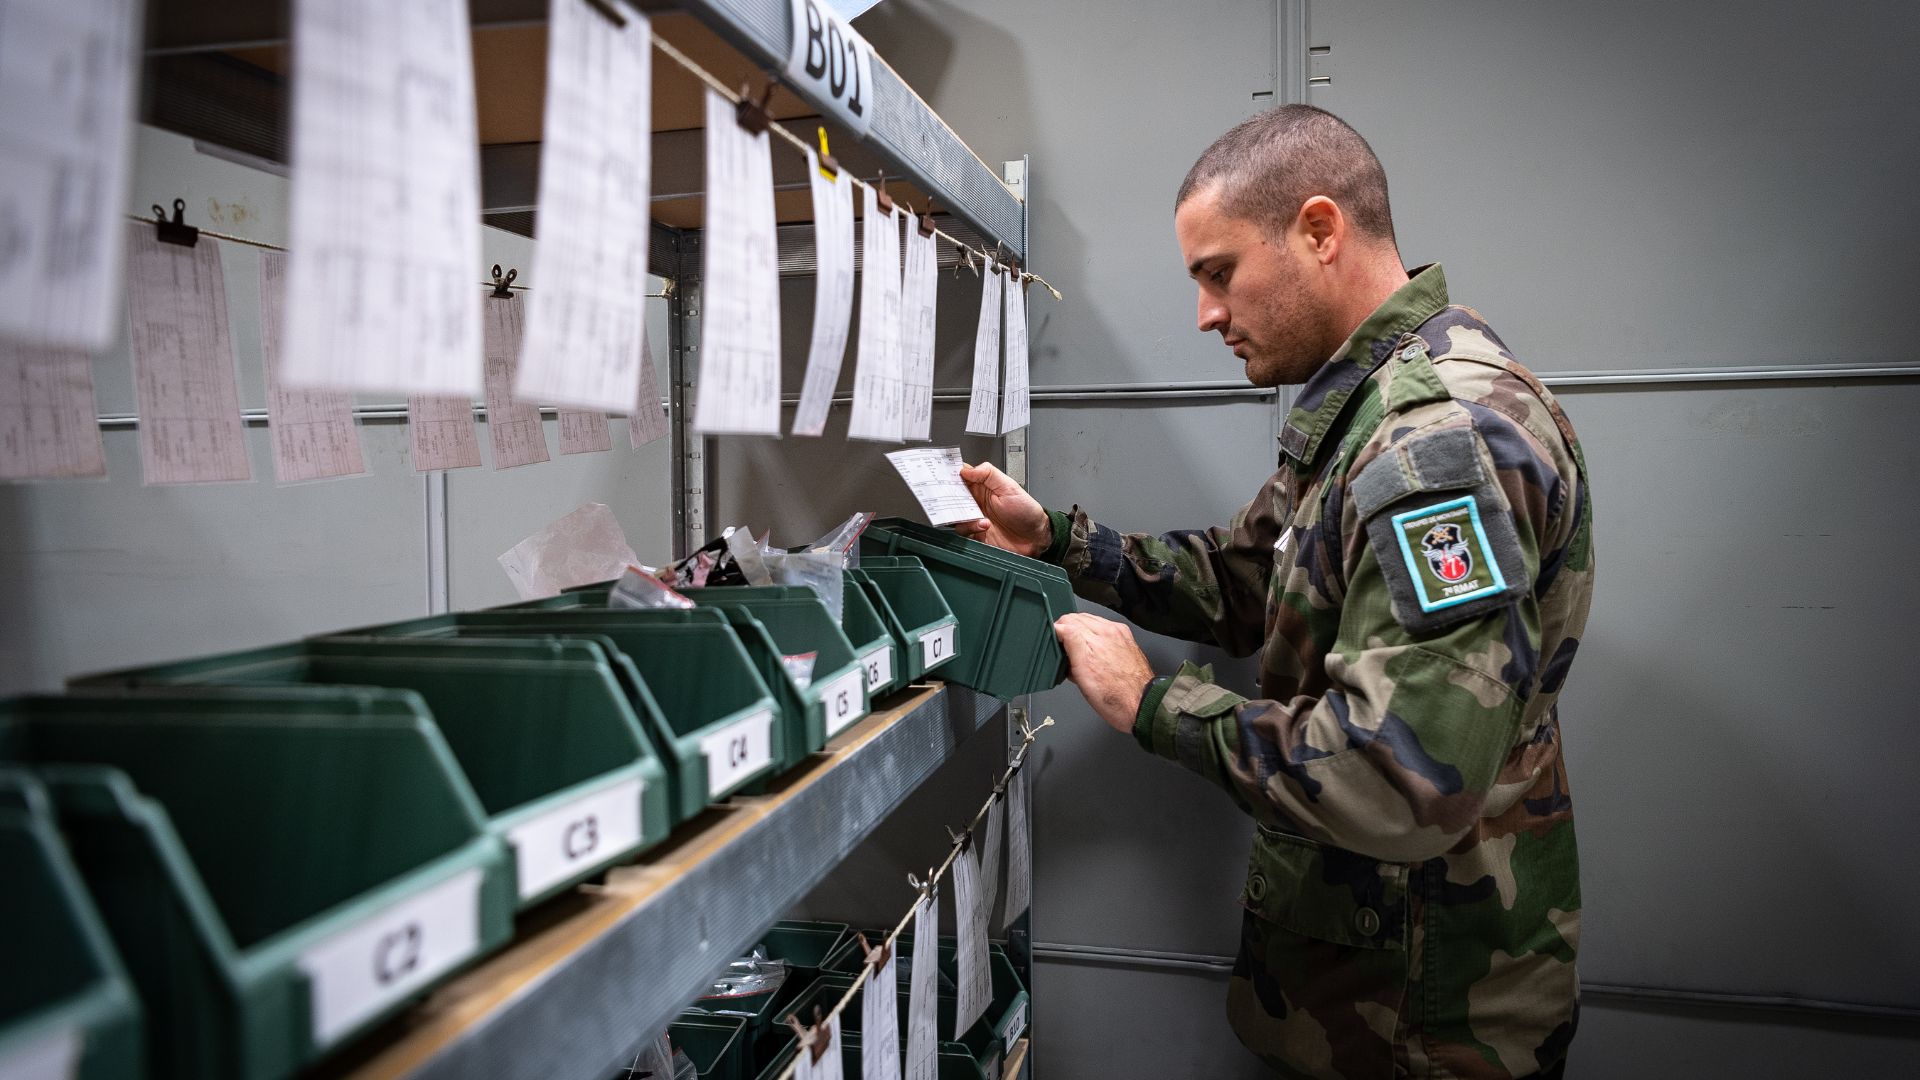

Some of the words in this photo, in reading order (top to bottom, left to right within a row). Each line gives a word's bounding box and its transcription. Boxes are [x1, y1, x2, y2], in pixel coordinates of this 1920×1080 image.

[805, 0, 863, 118] B01
[1447, 557, 1457, 577] 7
[1453, 580, 1479, 595] RMAT
[933, 637, 942, 658] C7
[868, 661, 878, 685] C6
[837, 691, 849, 717] C5
[728, 736, 749, 768] C4
[563, 814, 600, 861] C3
[372, 922, 423, 986] C2
[1009, 1016, 1020, 1039] B10
